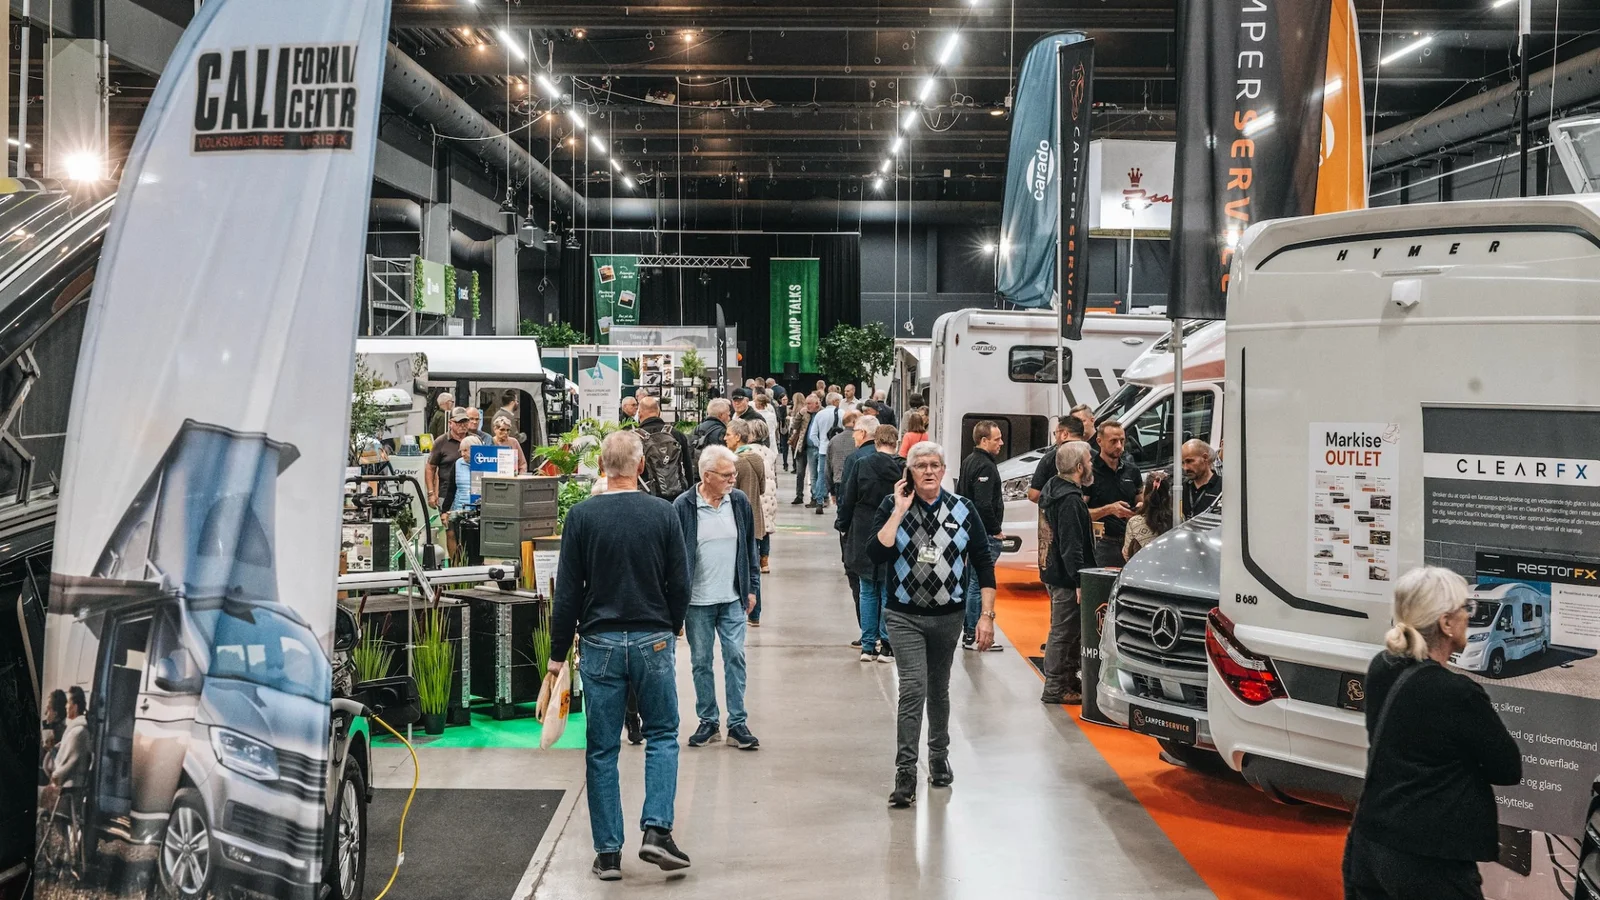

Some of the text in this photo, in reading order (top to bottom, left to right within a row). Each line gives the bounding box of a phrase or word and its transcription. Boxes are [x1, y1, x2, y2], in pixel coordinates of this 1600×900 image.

[194, 47, 291, 131] CALI
[1033, 139, 1050, 202] carado
[1336, 240, 1501, 261] HYMER
[788, 284, 802, 348] CAMP TALKS
[971, 344, 997, 352] carado
[1325, 431, 1382, 449] Markise
[1325, 450, 1382, 467] OUTLET
[394, 468, 419, 476] Oyster
[1235, 593, 1258, 605] B 680
[1145, 715, 1190, 733] CAMPERSERVICE
[1523, 732, 1534, 744] og
[1535, 733, 1598, 752] ridsemodstand
[1539, 758, 1580, 771] overflade
[1526, 779, 1538, 790] og
[1538, 780, 1562, 792] glans
